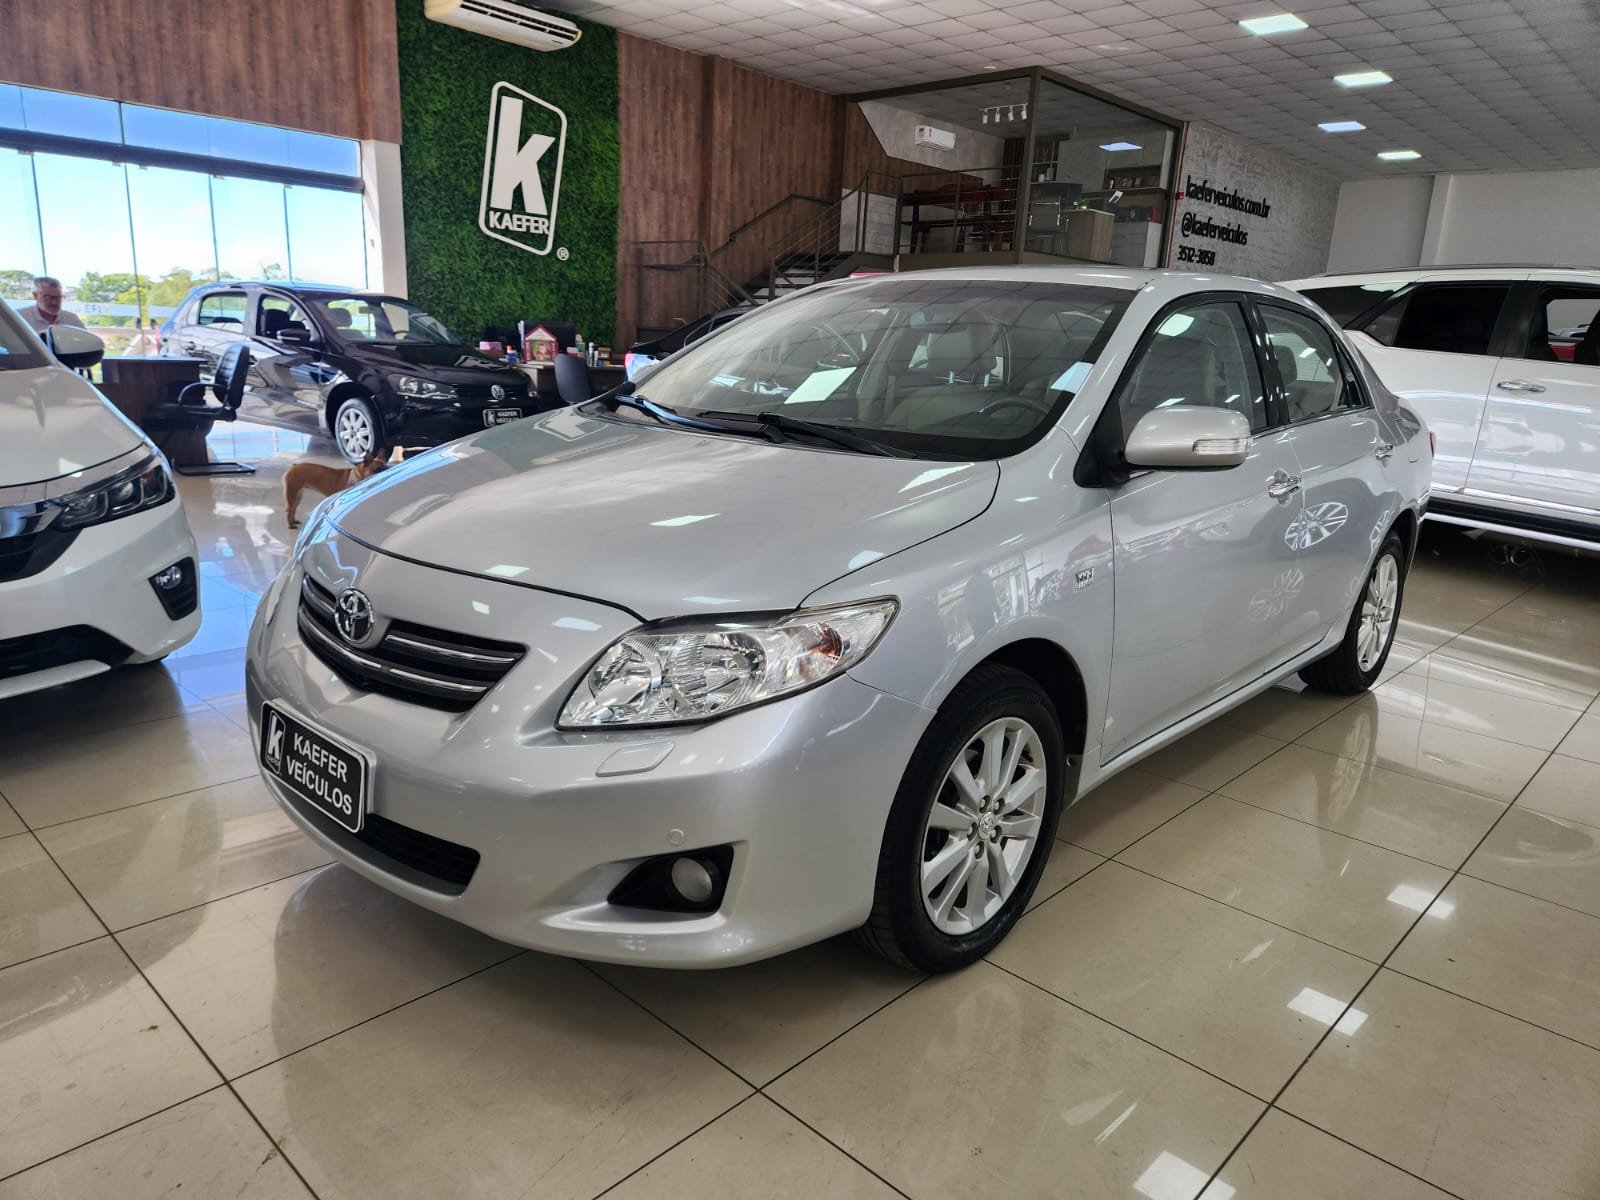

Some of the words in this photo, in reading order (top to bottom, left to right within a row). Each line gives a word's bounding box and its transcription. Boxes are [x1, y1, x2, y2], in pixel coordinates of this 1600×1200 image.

[1185, 175, 1271, 219] kaeferveiculos.com.br
[489, 211, 550, 235] KAEFER
[1181, 212, 1248, 246] @kaeferveiculos
[294, 732, 348, 783] KAEFER
[286, 755, 353, 815] VEÍCULOS
